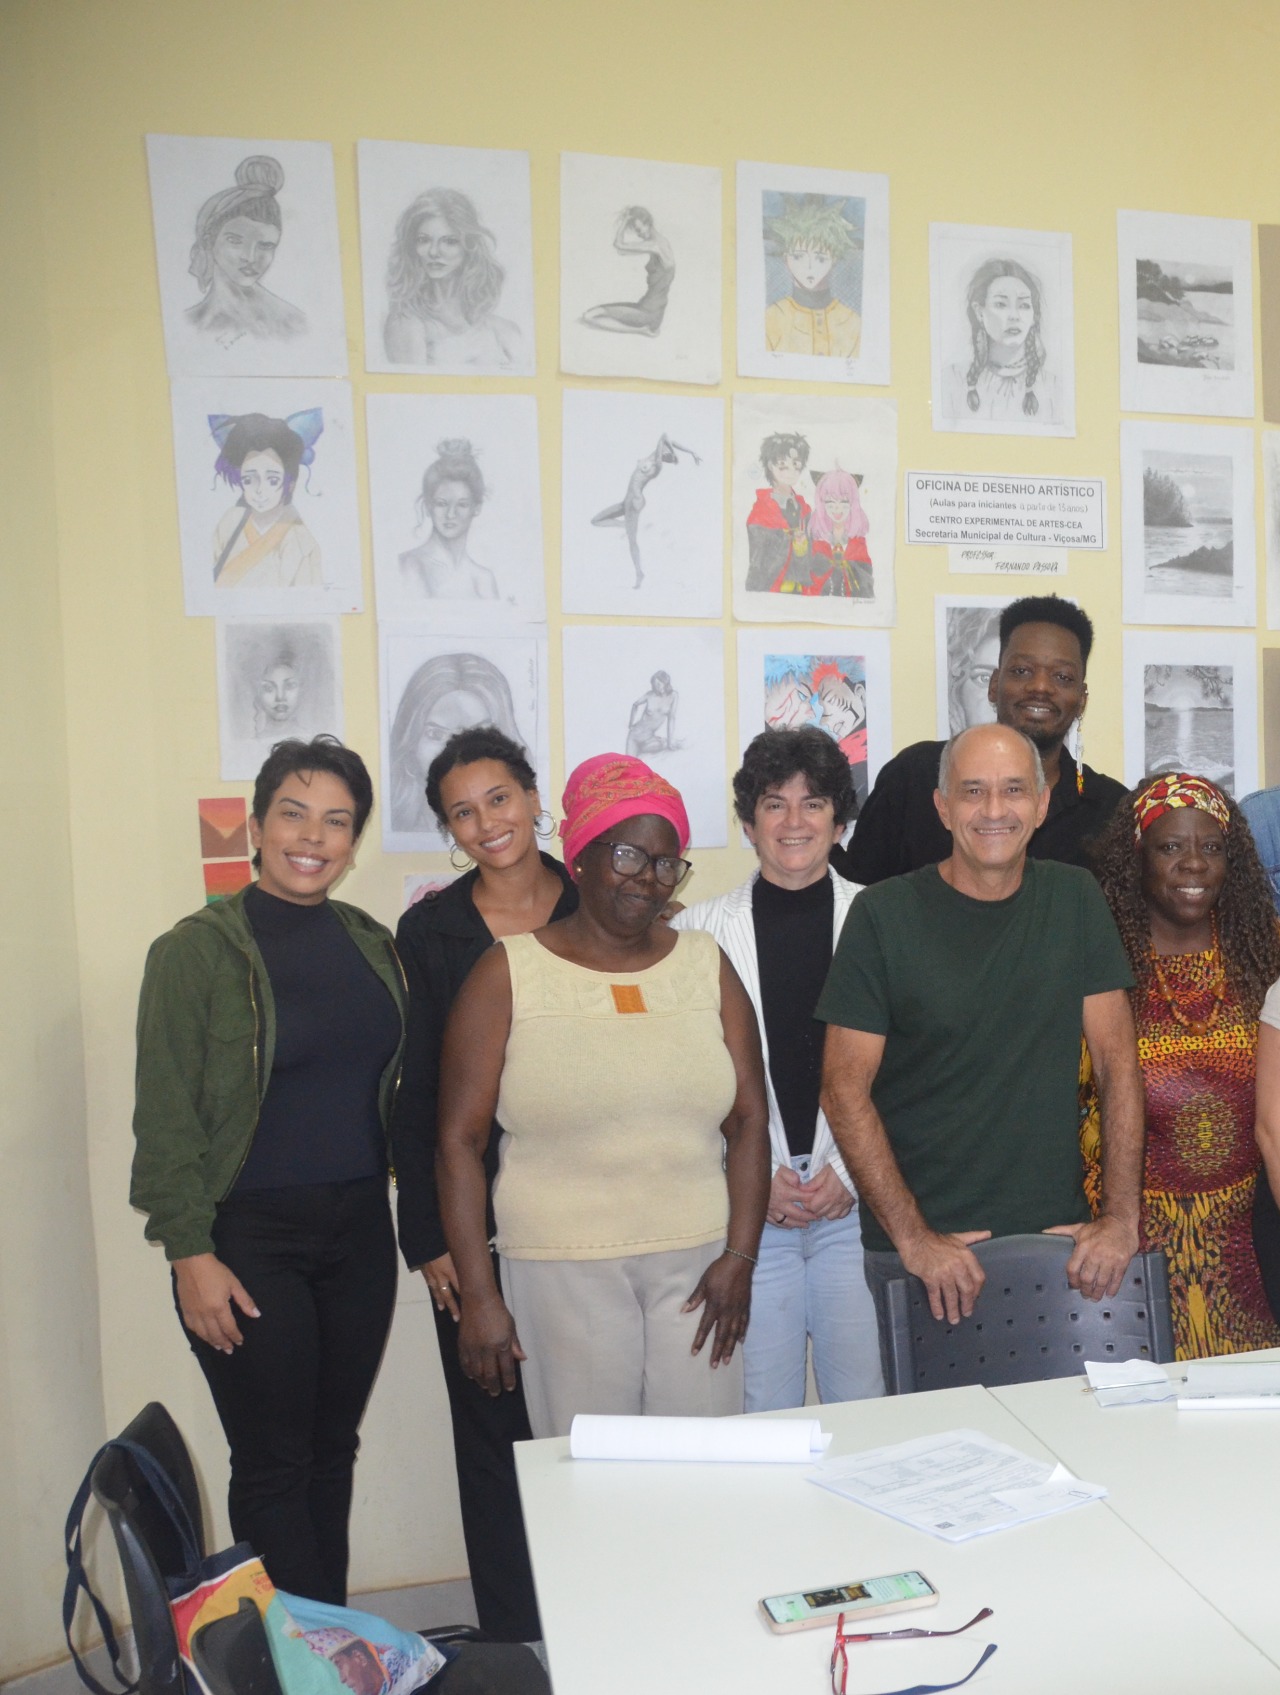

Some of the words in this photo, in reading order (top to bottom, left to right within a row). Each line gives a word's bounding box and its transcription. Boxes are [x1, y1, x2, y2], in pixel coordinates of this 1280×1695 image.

[916, 479, 961, 492] OFICINA
[964, 481, 979, 493] DE
[982, 483, 1036, 495] DESENHO
[1038, 483, 1095, 498] ARTÍSTICO
[929, 498, 956, 508] (Aulas
[958, 500, 976, 510] para
[978, 500, 1017, 510] iniciantes
[929, 516, 962, 525] CENTRO
[964, 517, 1024, 527] EXPERIMENTAL
[1026, 519, 1037, 527] DE
[1039, 520, 1083, 529] ARTES-CEA
[915, 528, 958, 539] Secretaria
[960, 530, 1002, 542] Municipal
[1004, 531, 1014, 541] de
[1016, 532, 1046, 542] Cultura
[1053, 533, 1097, 545] Viçosa/MG
